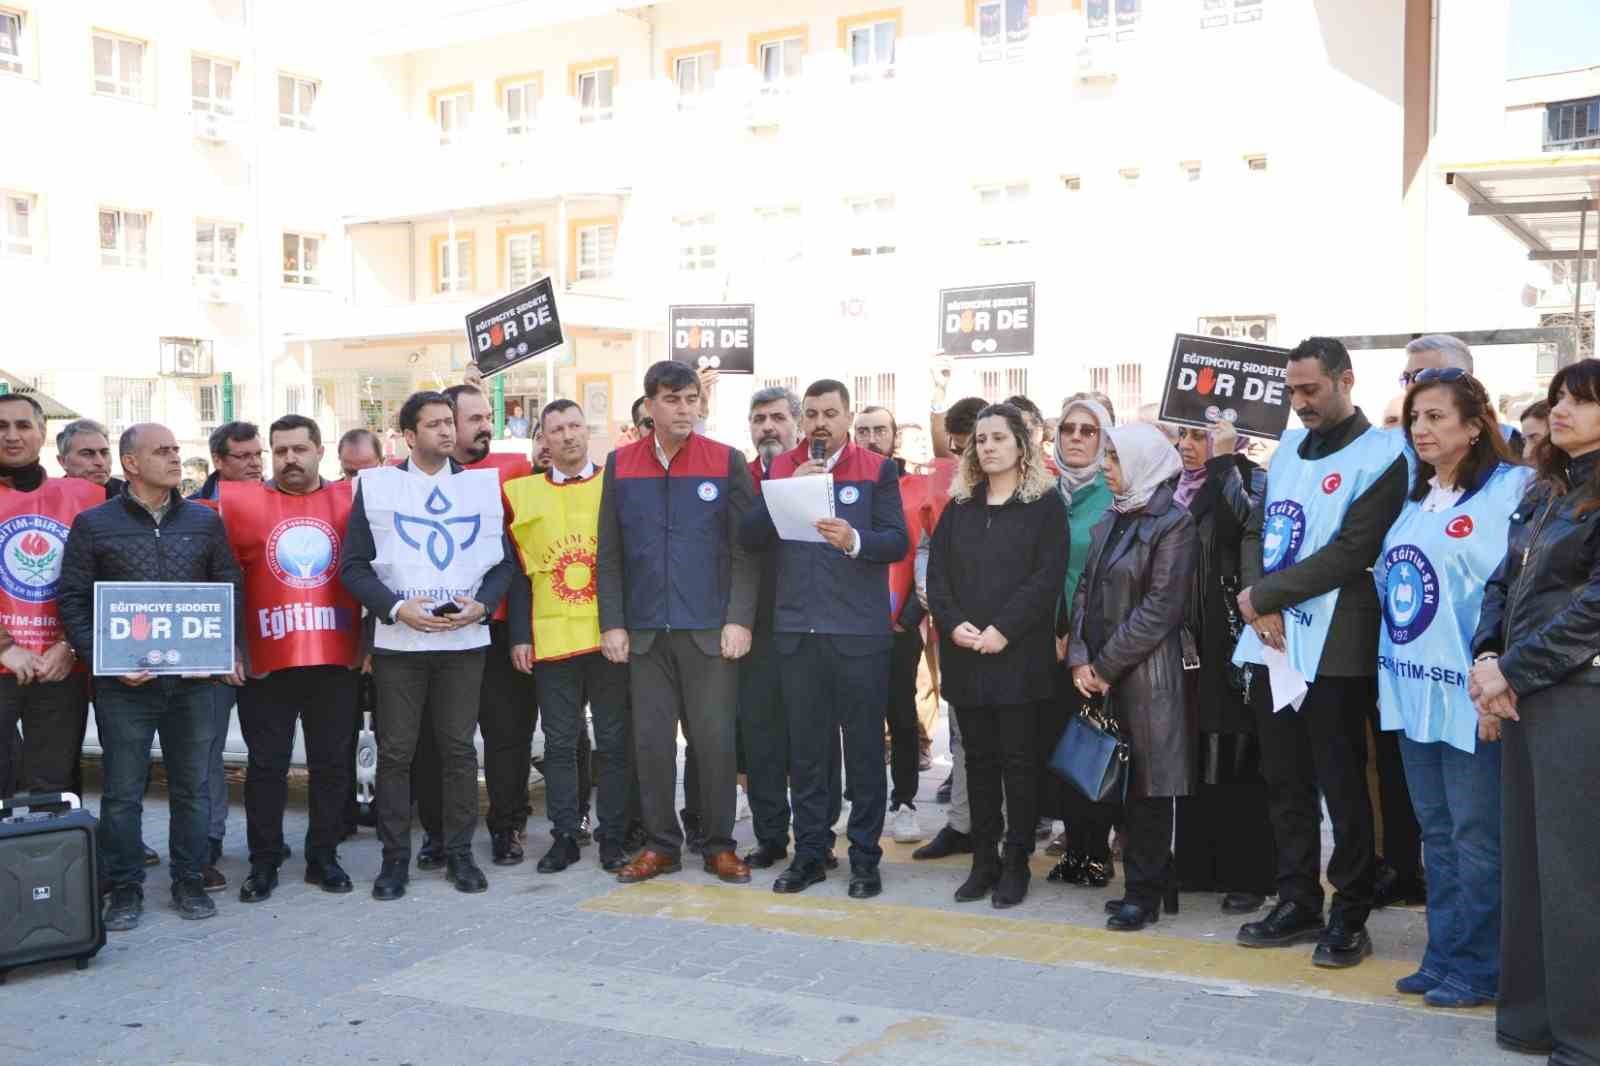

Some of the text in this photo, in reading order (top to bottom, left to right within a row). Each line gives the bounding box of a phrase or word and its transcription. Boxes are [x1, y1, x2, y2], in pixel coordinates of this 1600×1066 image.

[477, 305, 552, 353] DR DE
[946, 308, 1029, 334] DR DE
[675, 327, 749, 351] DR DE
[1242, 362, 1287, 378] ŞİDDETE
[1177, 366, 1285, 406] DR DE
[175, 602, 222, 614] ŞİDDETE
[258, 602, 337, 641] Eğitim
[109, 612, 223, 641] DR DE
